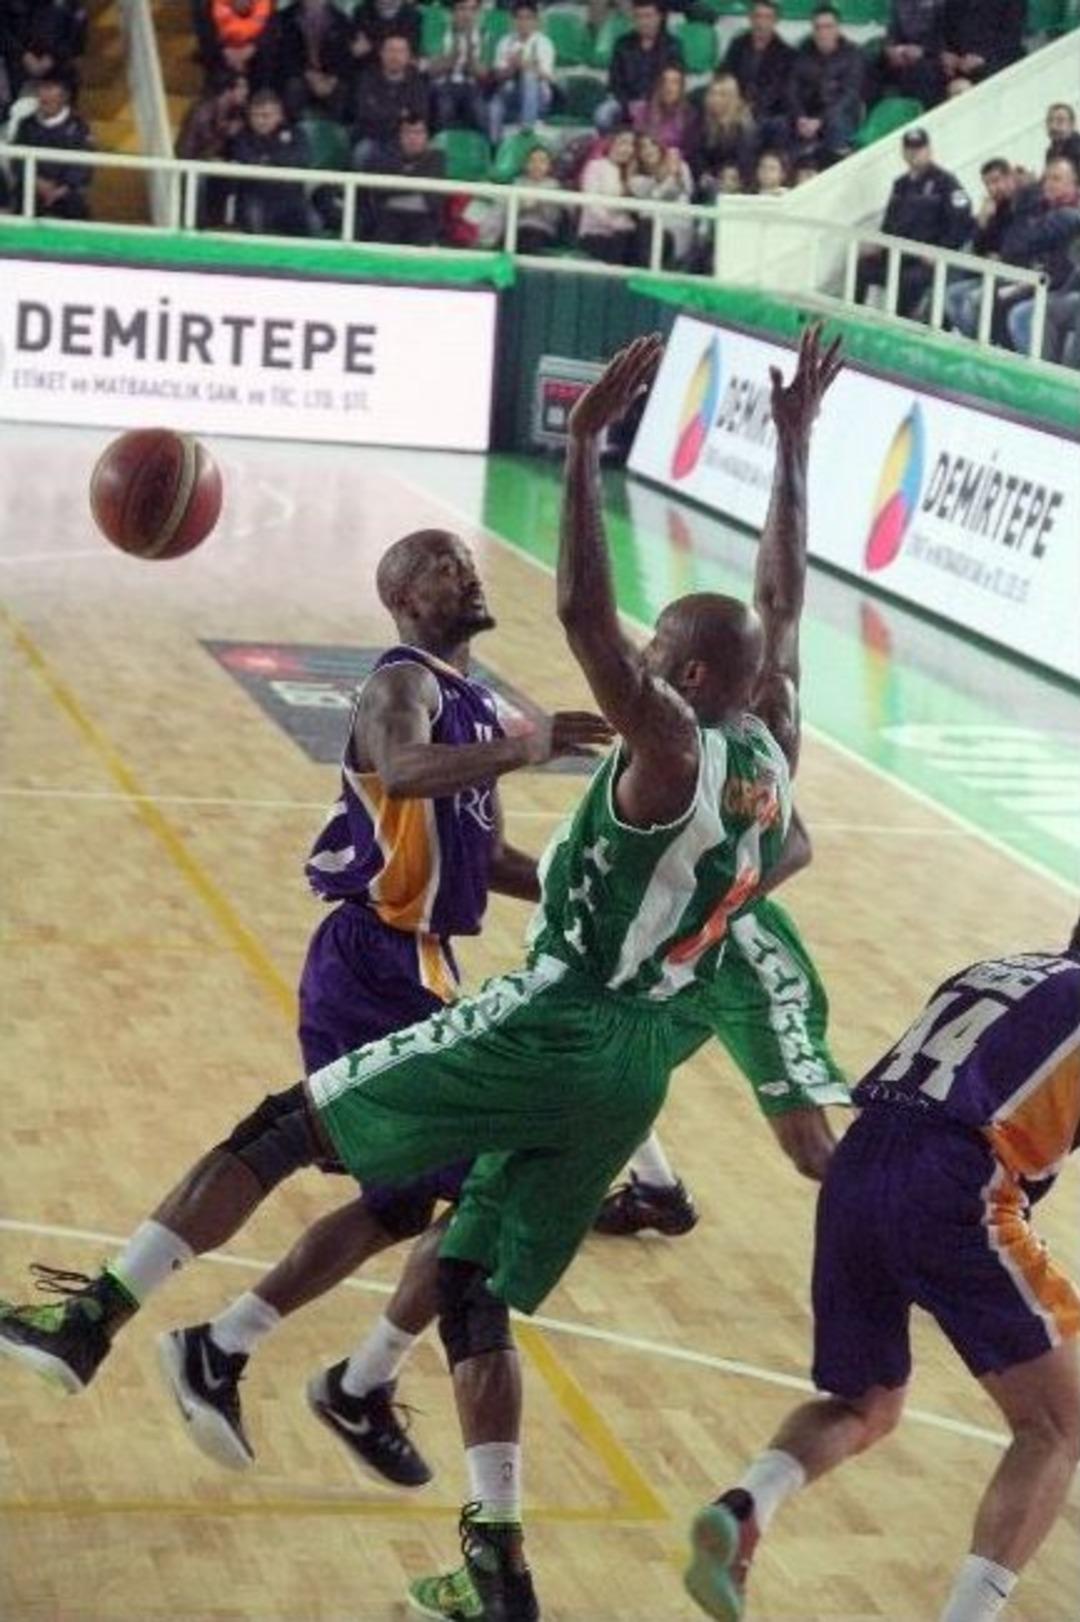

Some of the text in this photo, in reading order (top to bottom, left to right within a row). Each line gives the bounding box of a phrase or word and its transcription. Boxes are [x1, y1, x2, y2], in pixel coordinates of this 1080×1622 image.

[16, 296, 377, 375] DEMİRTEPE
[922, 449, 1065, 559] DEMİRTEPE
[878, 992, 1009, 1102] 44
